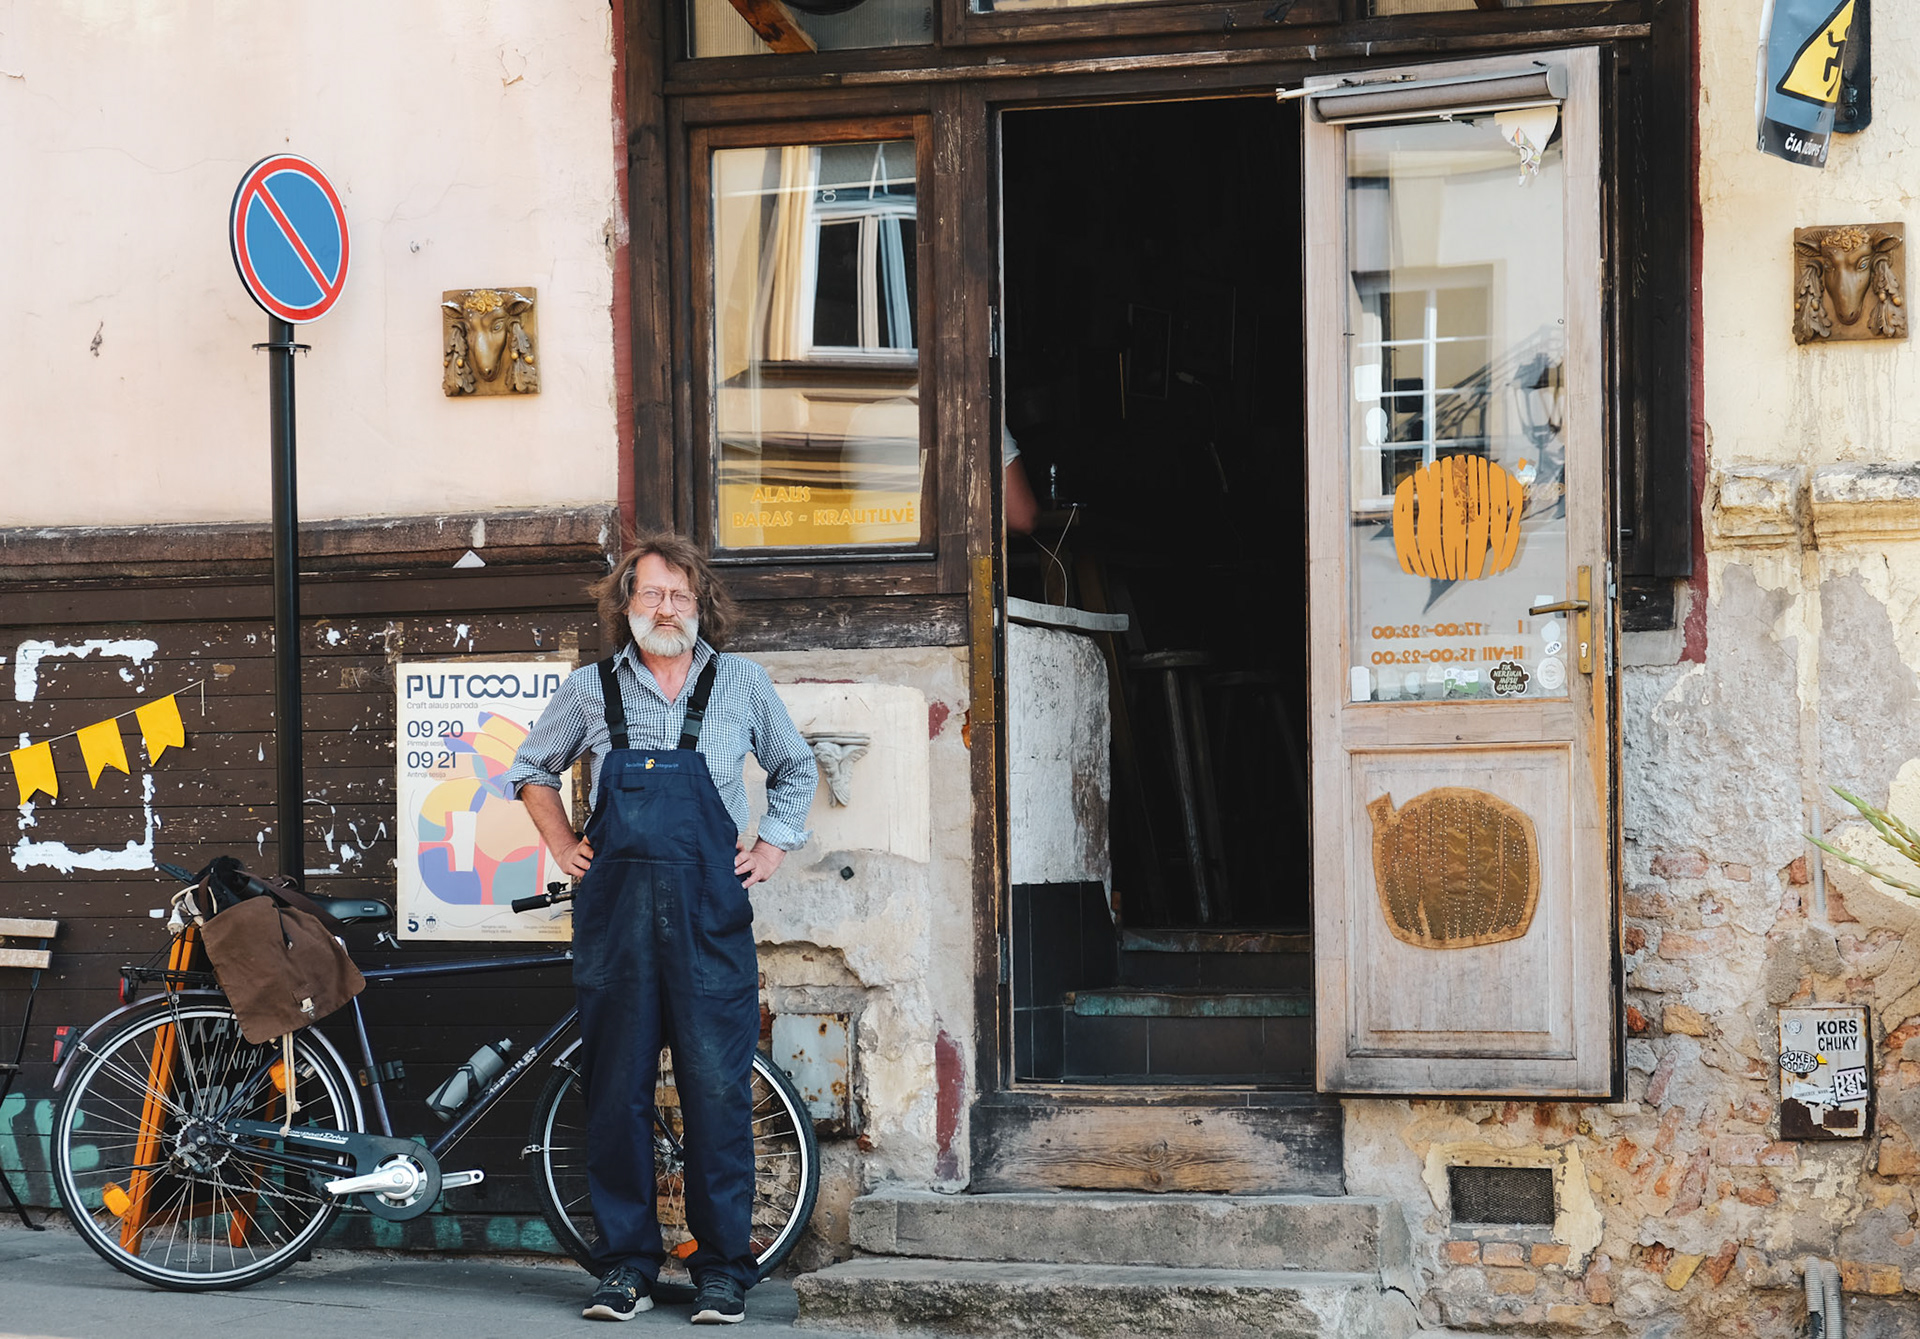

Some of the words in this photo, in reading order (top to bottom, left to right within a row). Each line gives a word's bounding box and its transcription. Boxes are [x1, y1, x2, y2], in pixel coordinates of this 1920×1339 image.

[1785, 132, 1803, 153] ČIA
[750, 486, 811, 503] ALAUS
[732, 511, 793, 528] BARAS
[813, 501, 915, 525] KRAUTUVĖ
[407, 702, 427, 710] Craft
[428, 702, 449, 710] alaus
[450, 702, 479, 710] paroda
[407, 720, 433, 738] 09
[438, 720, 464, 738] 20
[407, 751, 433, 769] 09
[438, 751, 456, 769] 21
[1817, 1020, 1857, 1035] KORS
[1818, 1036, 1858, 1051] CHUKY
